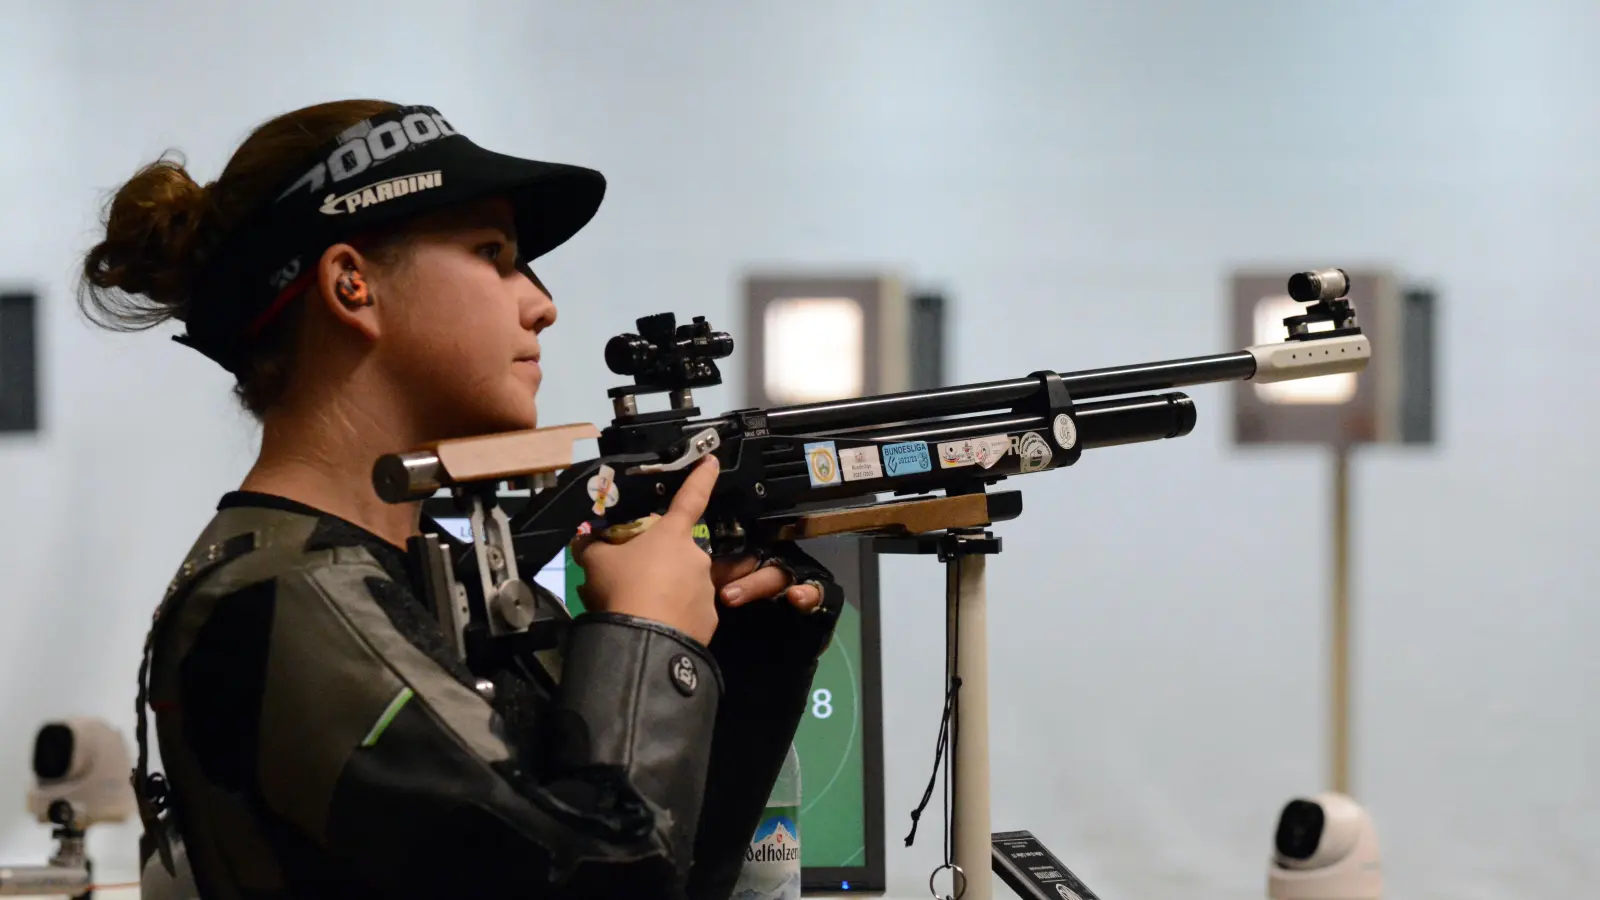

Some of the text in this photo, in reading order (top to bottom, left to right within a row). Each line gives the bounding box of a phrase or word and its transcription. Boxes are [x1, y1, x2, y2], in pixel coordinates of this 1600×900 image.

[344, 171, 443, 214] PARDINI
[884, 443, 927, 456] BUNDESLIGA
[897, 456, 918, 465] 2022/23
[811, 688, 833, 719] 8
